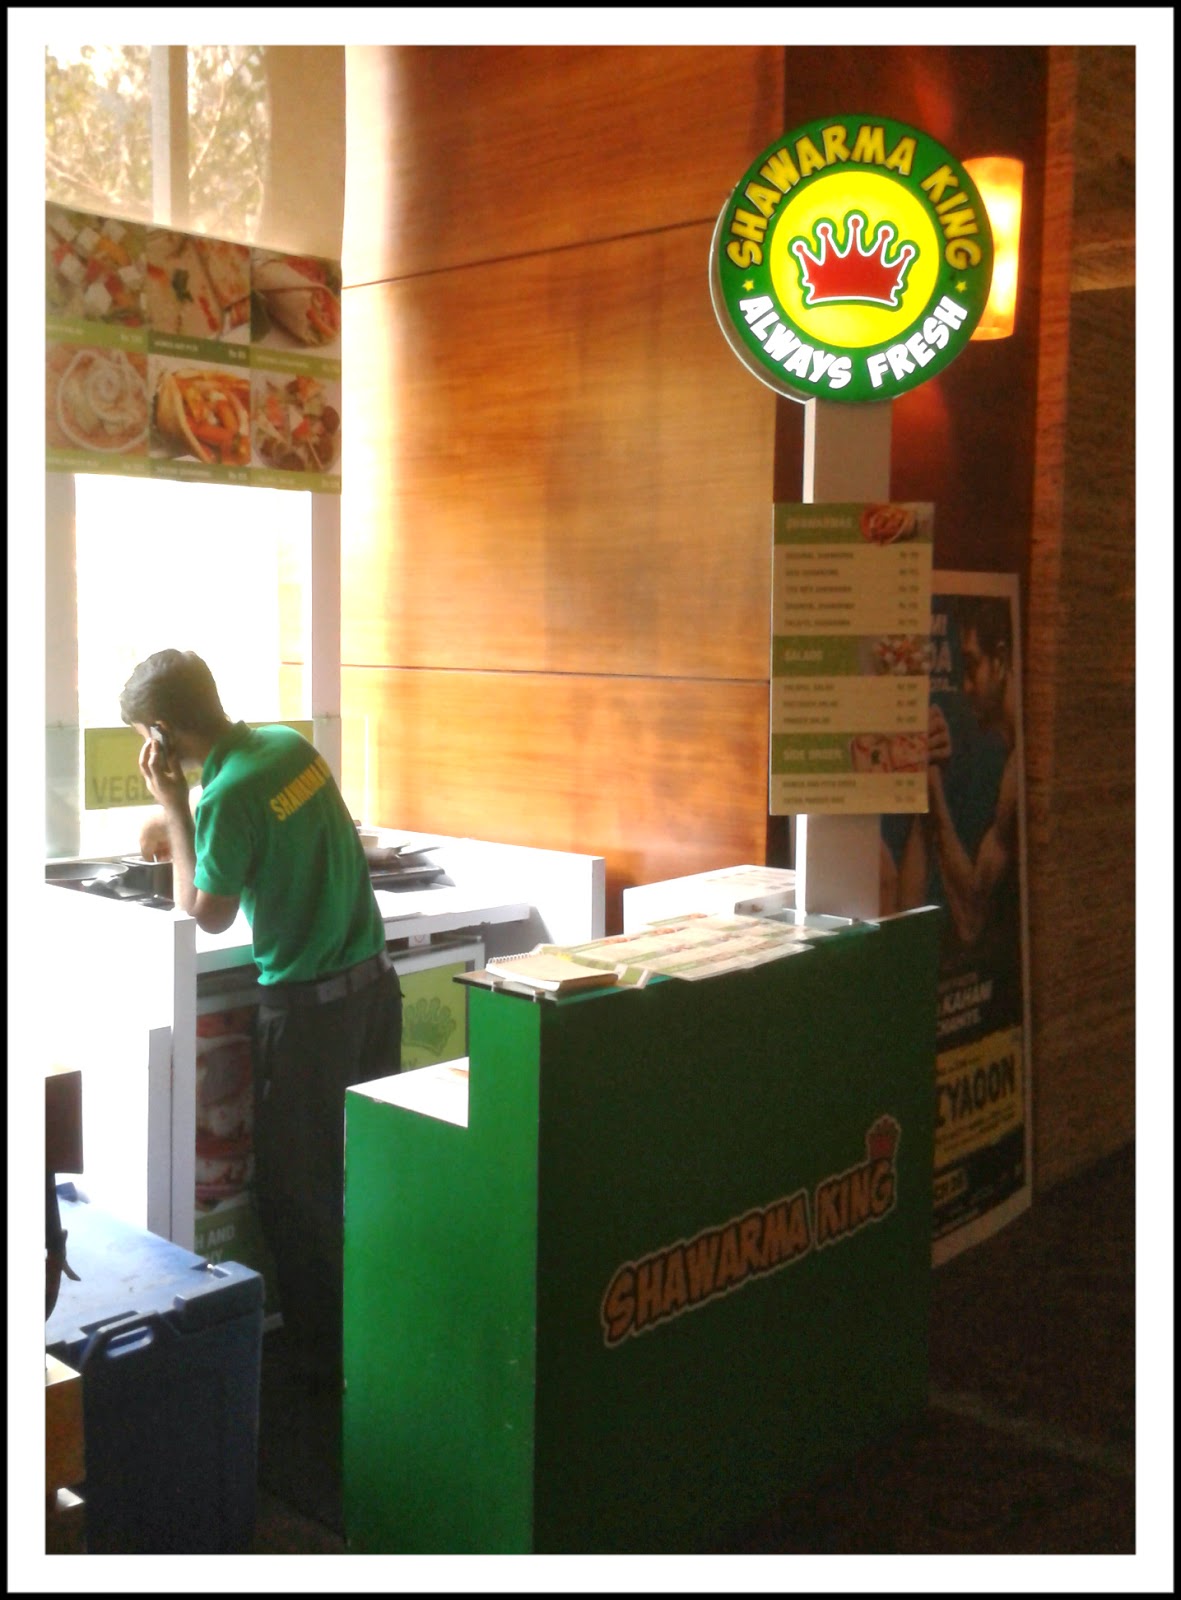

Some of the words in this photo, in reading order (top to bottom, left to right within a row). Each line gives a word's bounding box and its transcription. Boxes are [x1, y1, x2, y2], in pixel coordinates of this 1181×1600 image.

[726, 124, 918, 269] SHAWARMA
[921, 164, 983, 270] KING
[739, 295, 853, 390] ALWAYS
[866, 295, 969, 389] FRESH
[603, 1191, 811, 1345] SHAWARMA
[816, 1160, 896, 1249] KING
